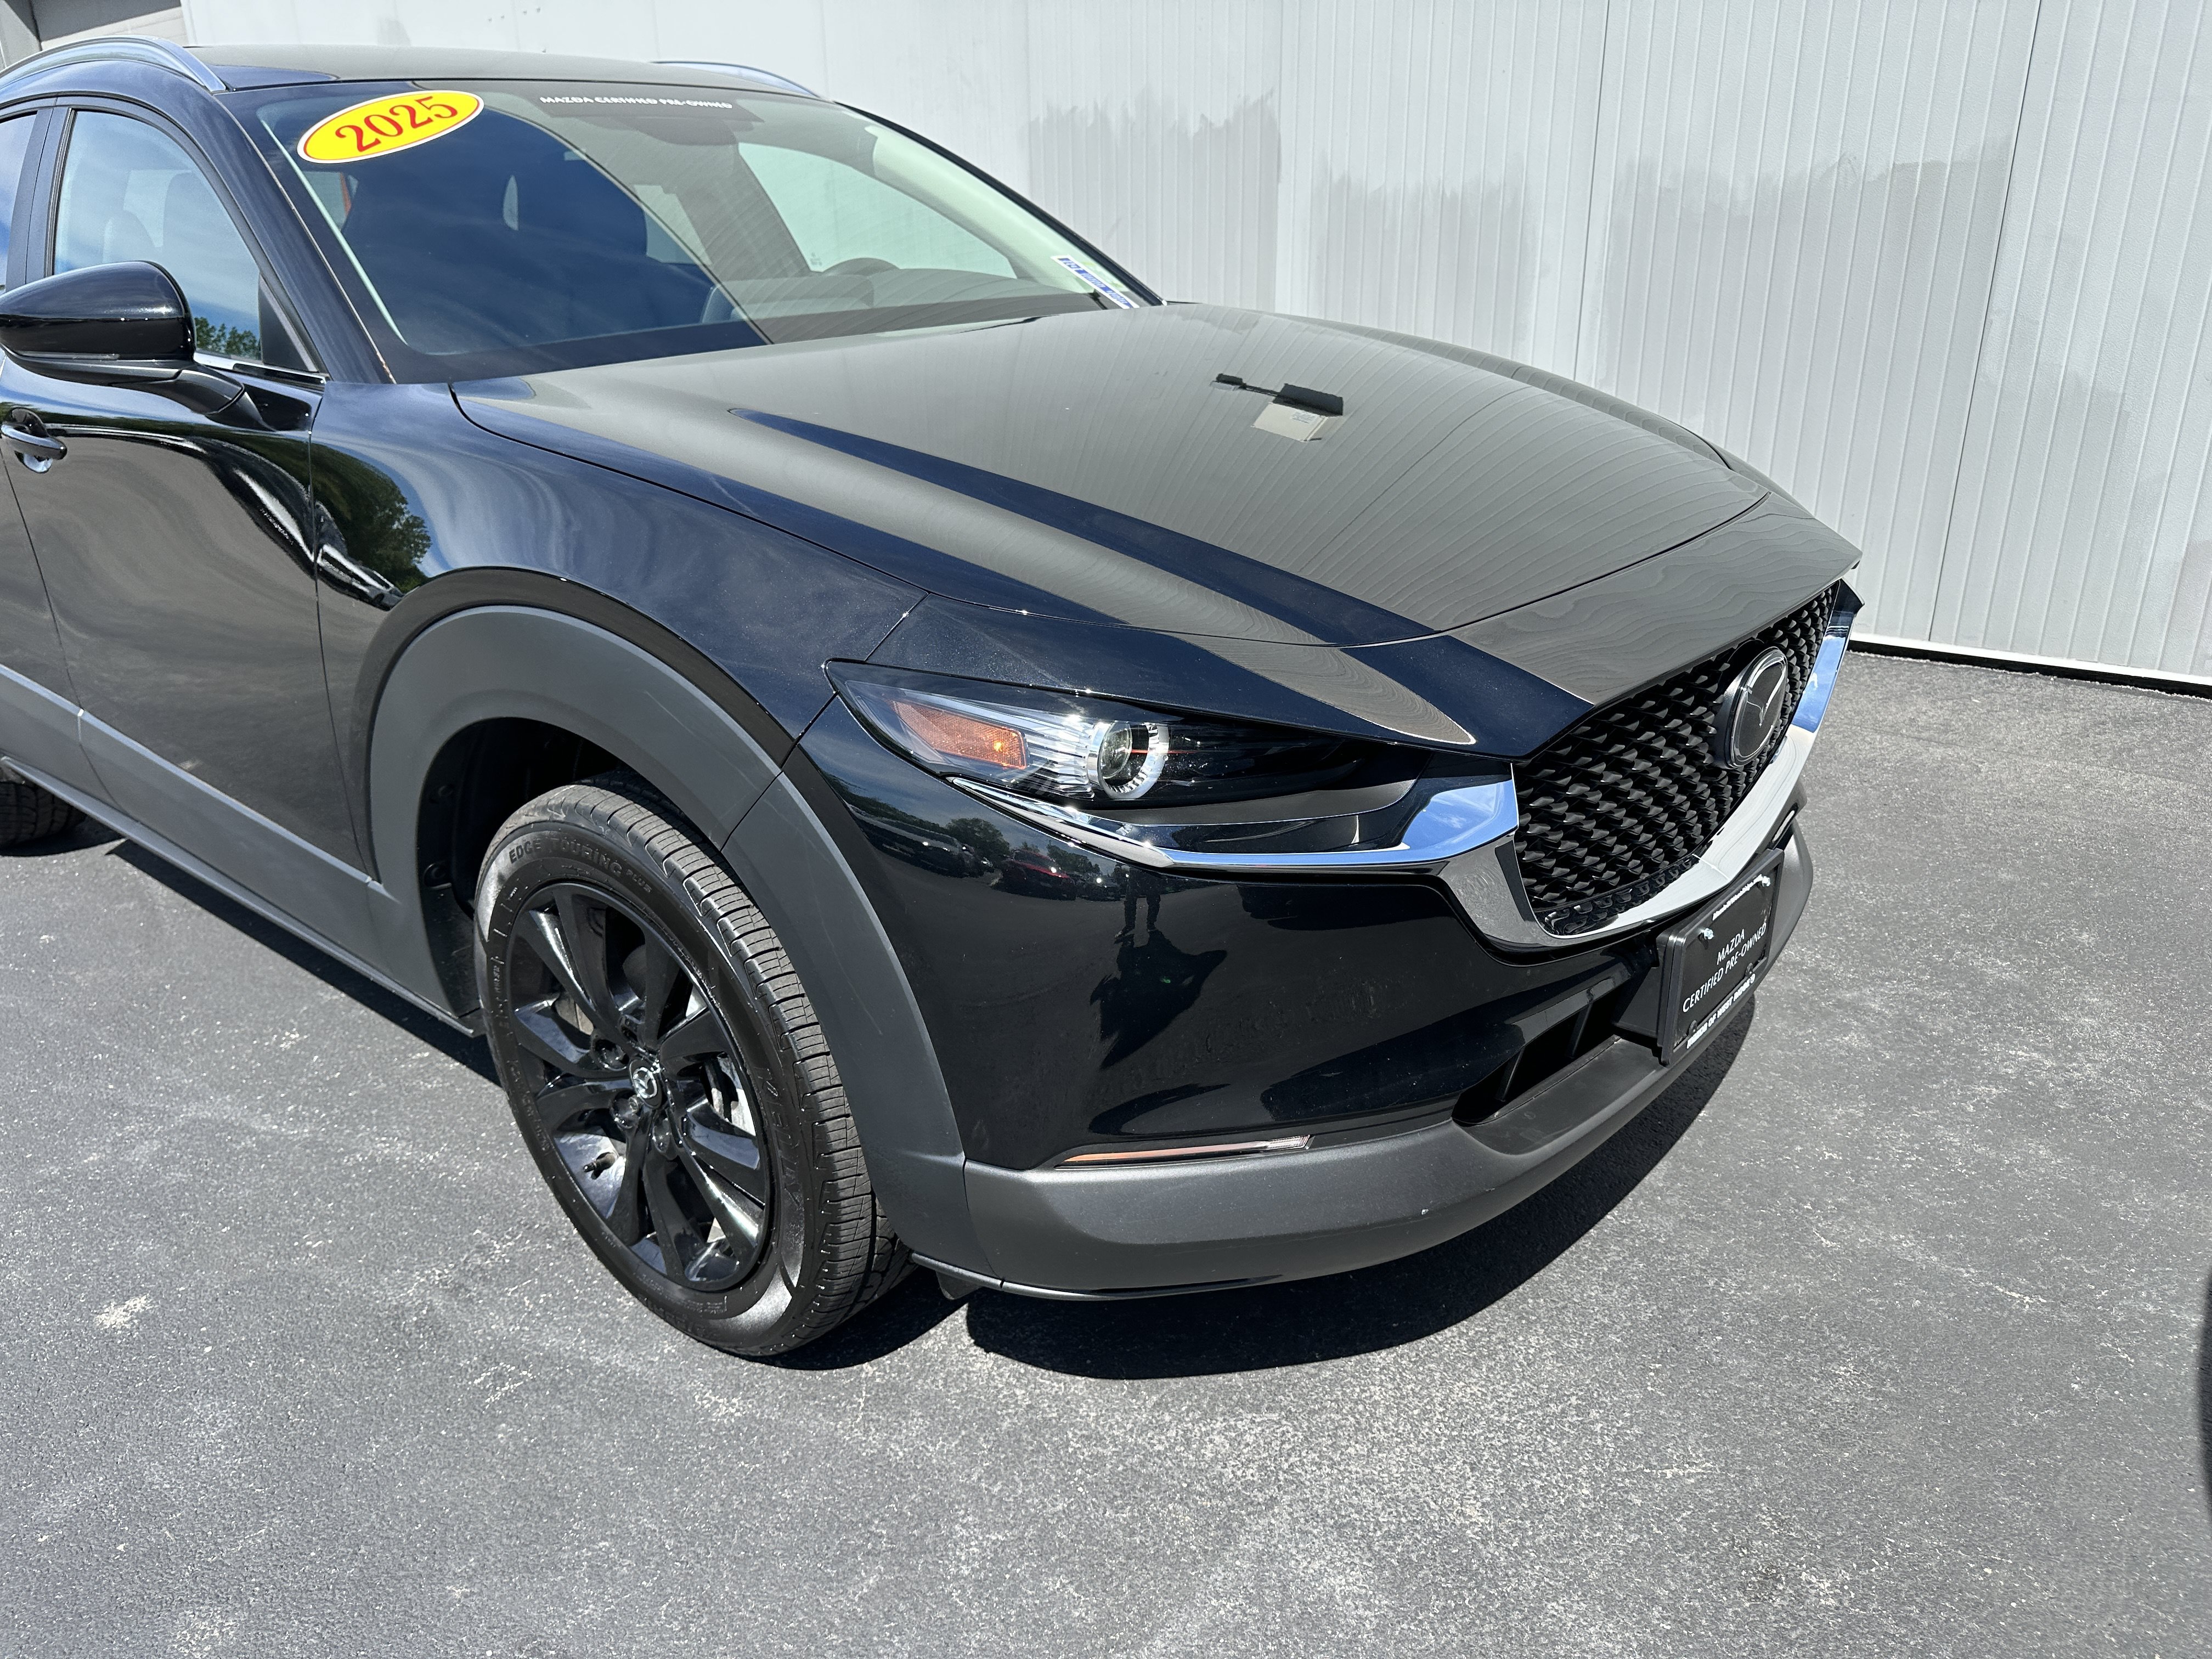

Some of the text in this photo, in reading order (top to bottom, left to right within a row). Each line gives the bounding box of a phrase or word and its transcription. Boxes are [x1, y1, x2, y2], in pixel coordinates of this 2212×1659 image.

[335, 96, 458, 152] 2025
[1683, 922, 1767, 1013] CERTIFIED PRE-OWNED
[1717, 928, 1745, 966] MAZDA
